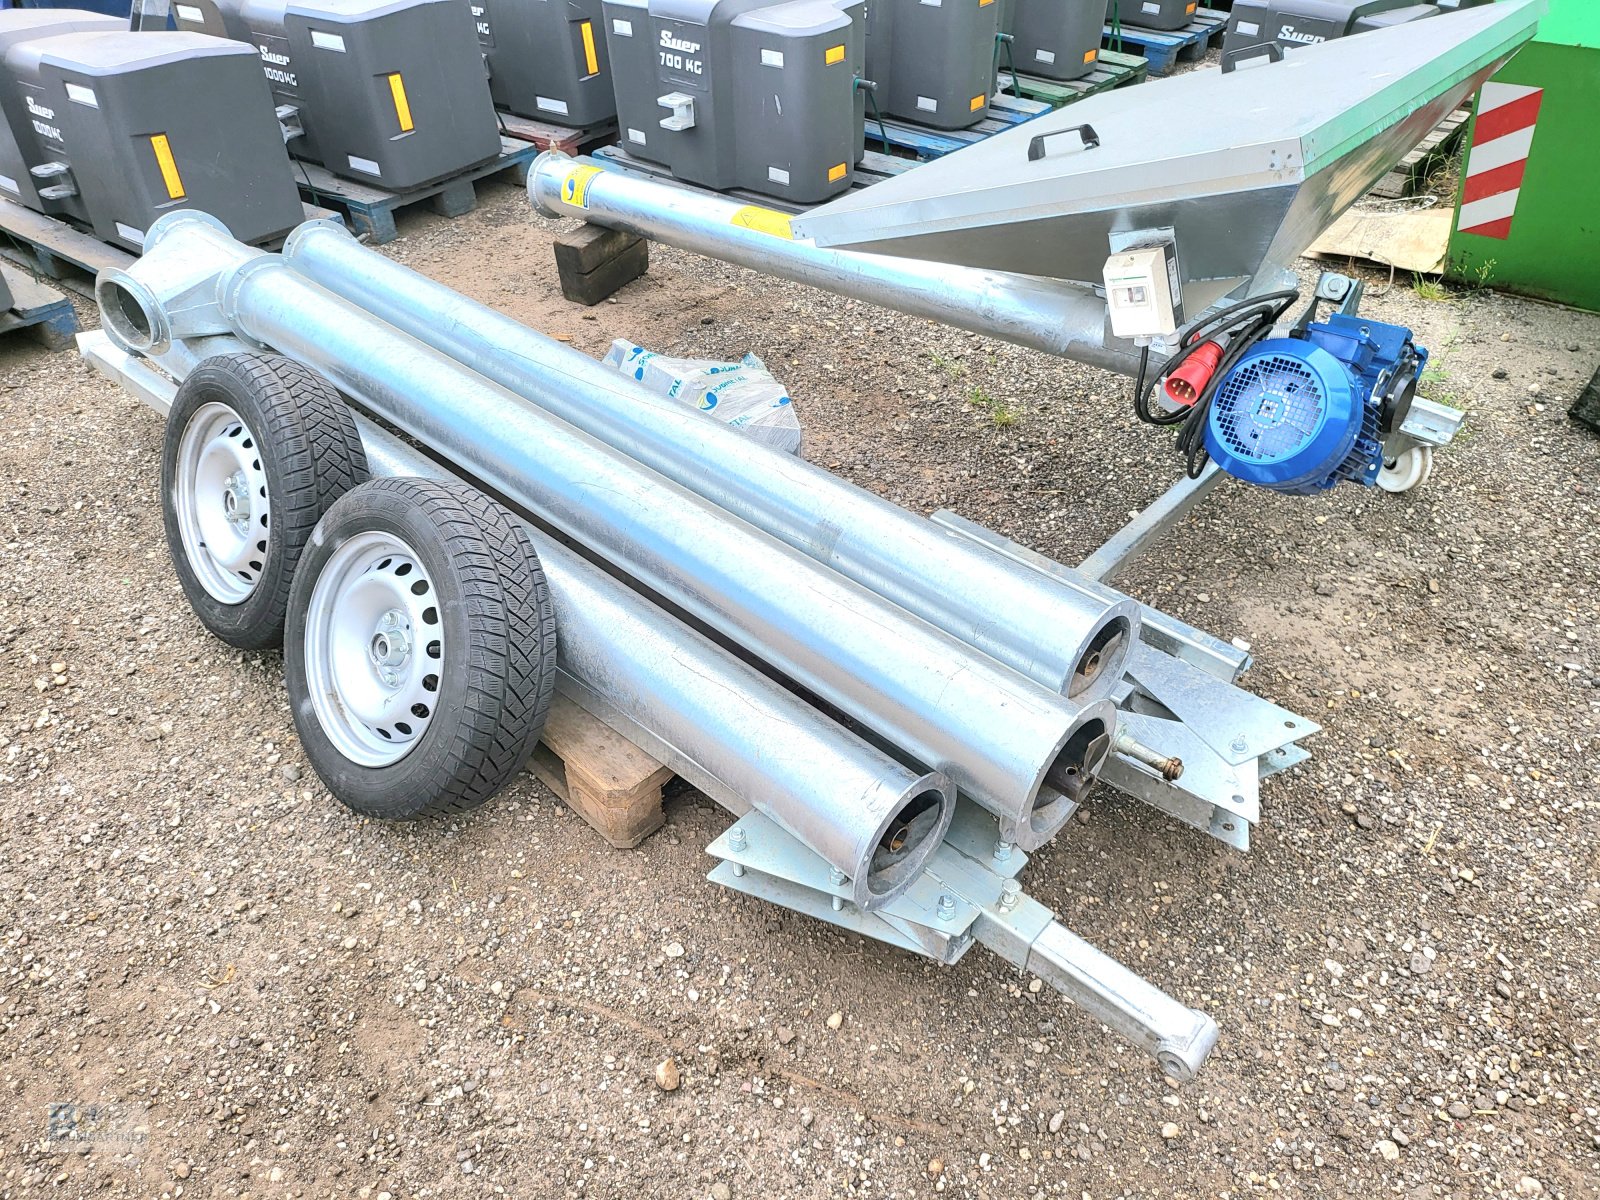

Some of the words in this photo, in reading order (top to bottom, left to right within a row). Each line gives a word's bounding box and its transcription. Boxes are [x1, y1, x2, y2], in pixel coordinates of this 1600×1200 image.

[659, 29, 701, 54] Suer
[259, 44, 290, 66] Suer
[659, 51, 682, 70] 700
[685, 58, 703, 75] KG
[25, 95, 55, 120] Suer
